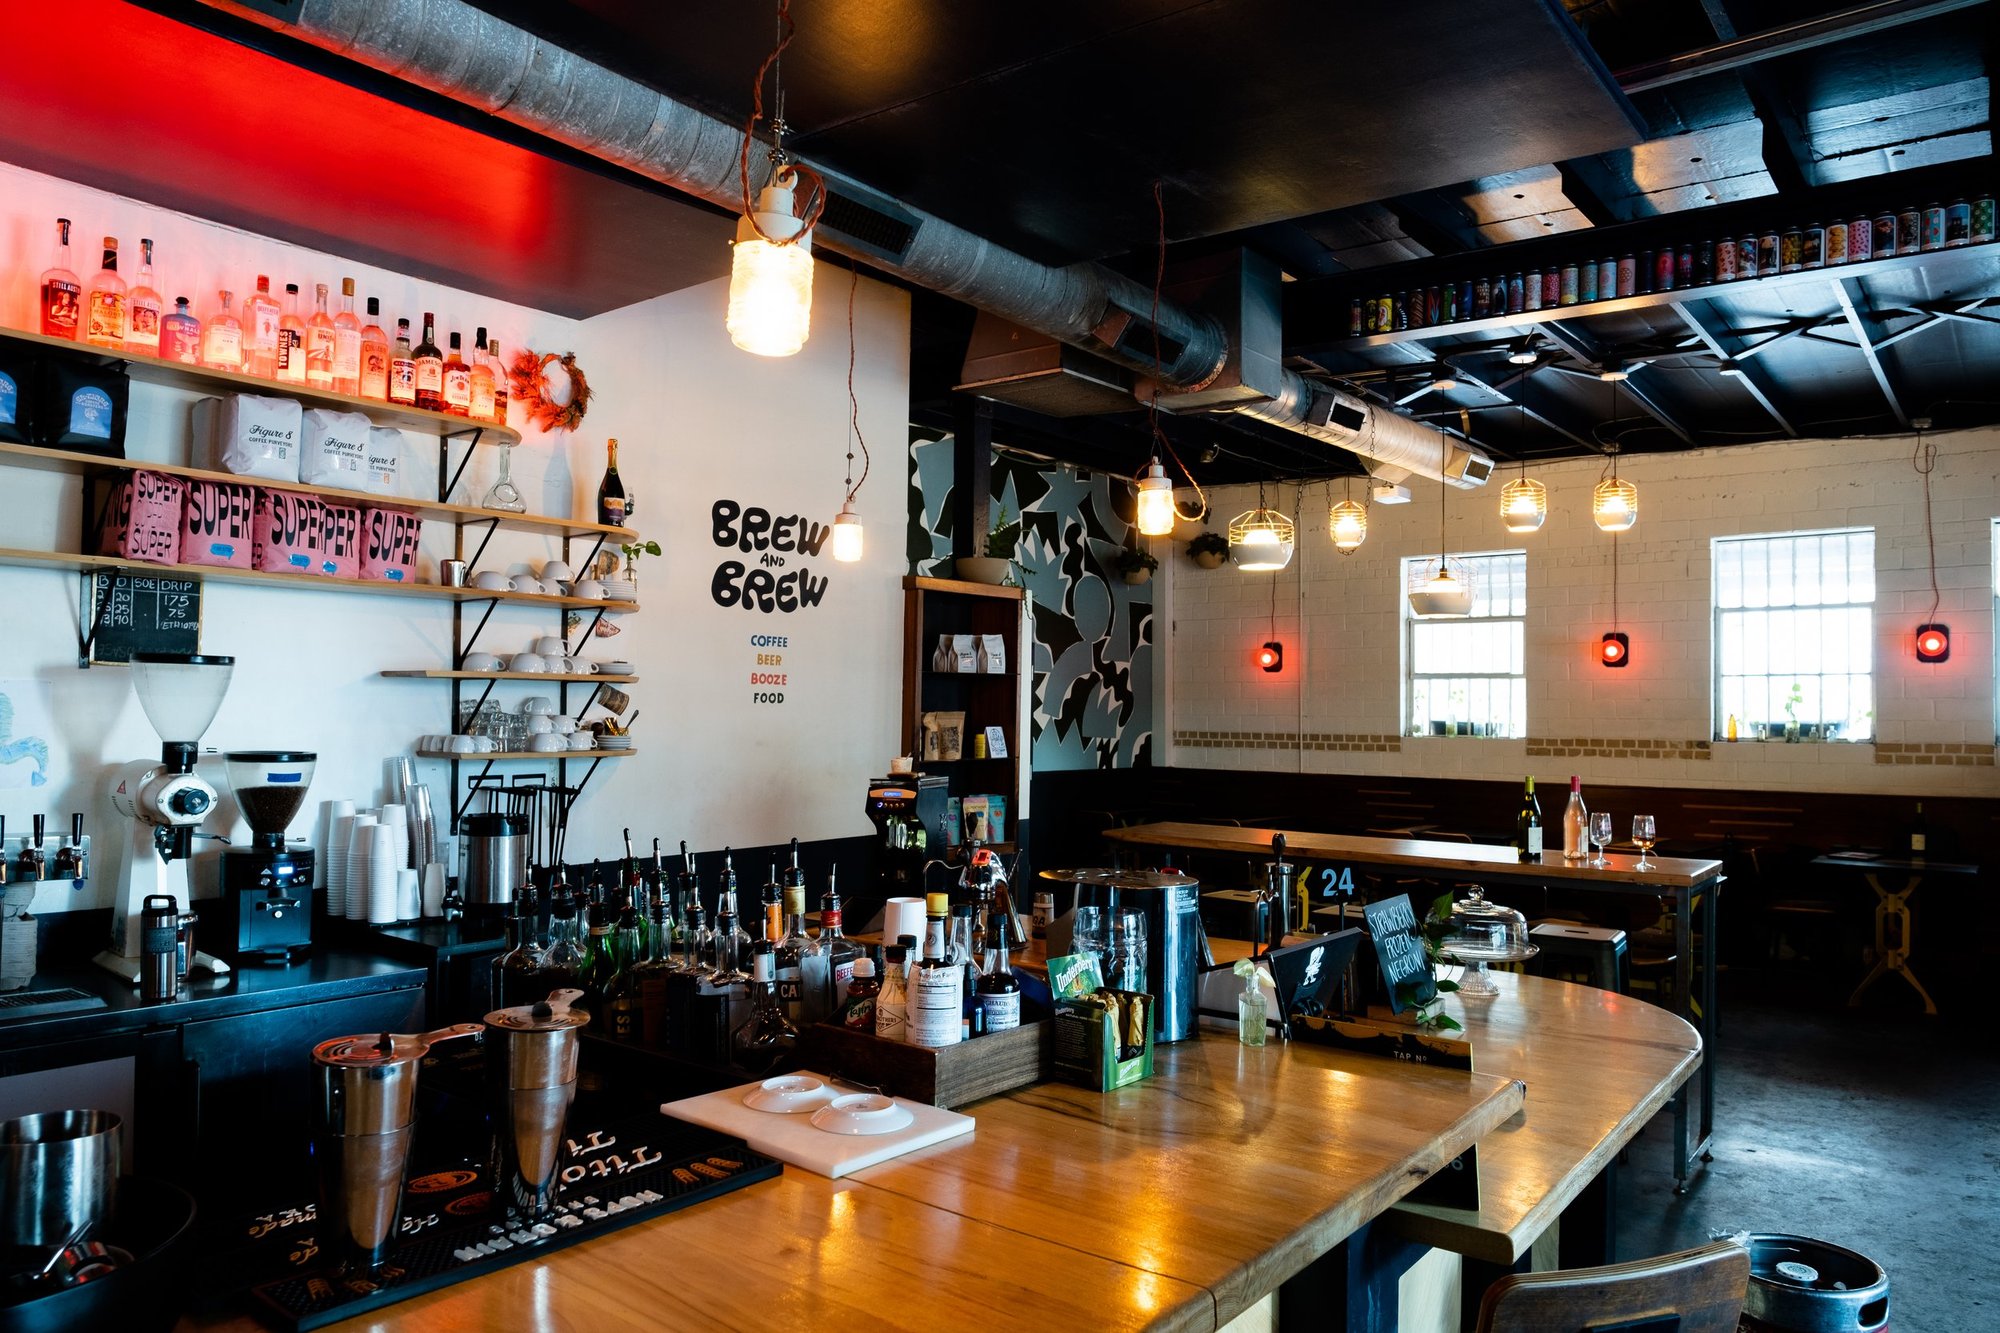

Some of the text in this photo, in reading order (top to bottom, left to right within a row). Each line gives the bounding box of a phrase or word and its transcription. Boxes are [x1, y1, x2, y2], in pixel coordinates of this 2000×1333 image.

[279, 331, 288, 366] TOWNES
[249, 424, 294, 440] Figure 8
[268, 439, 293, 448] PURVEYORS
[324, 437, 365, 452] Figure 8
[369, 454, 397, 466] igure 8
[138, 473, 178, 503] SUPER
[189, 481, 250, 540] SUPER
[272, 494, 326, 551] SUPER
[712, 499, 830, 557] BREW
[324, 508, 356, 558] PER
[369, 511, 421, 567] SUPER
[132, 528, 172, 558] SUPER
[760, 552, 785, 567] AND
[161, 580, 192, 591] DRIP
[711, 560, 829, 614] BREW
[115, 592, 130, 602] 20
[114, 603, 130, 615] 25
[750, 634, 788, 648] COFFEE
[757, 653, 782, 666] BEER
[750, 672, 787, 686] BOOZE
[753, 692, 785, 704] FOOD
[1321, 867, 1355, 897] 24
[1384, 929, 1413, 960] FROZEN
[836, 966, 854, 982] BEEFE
[1055, 958, 1094, 993] Underberg
[780, 984, 800, 998] CA
[1393, 1050, 1412, 1060] TAP
